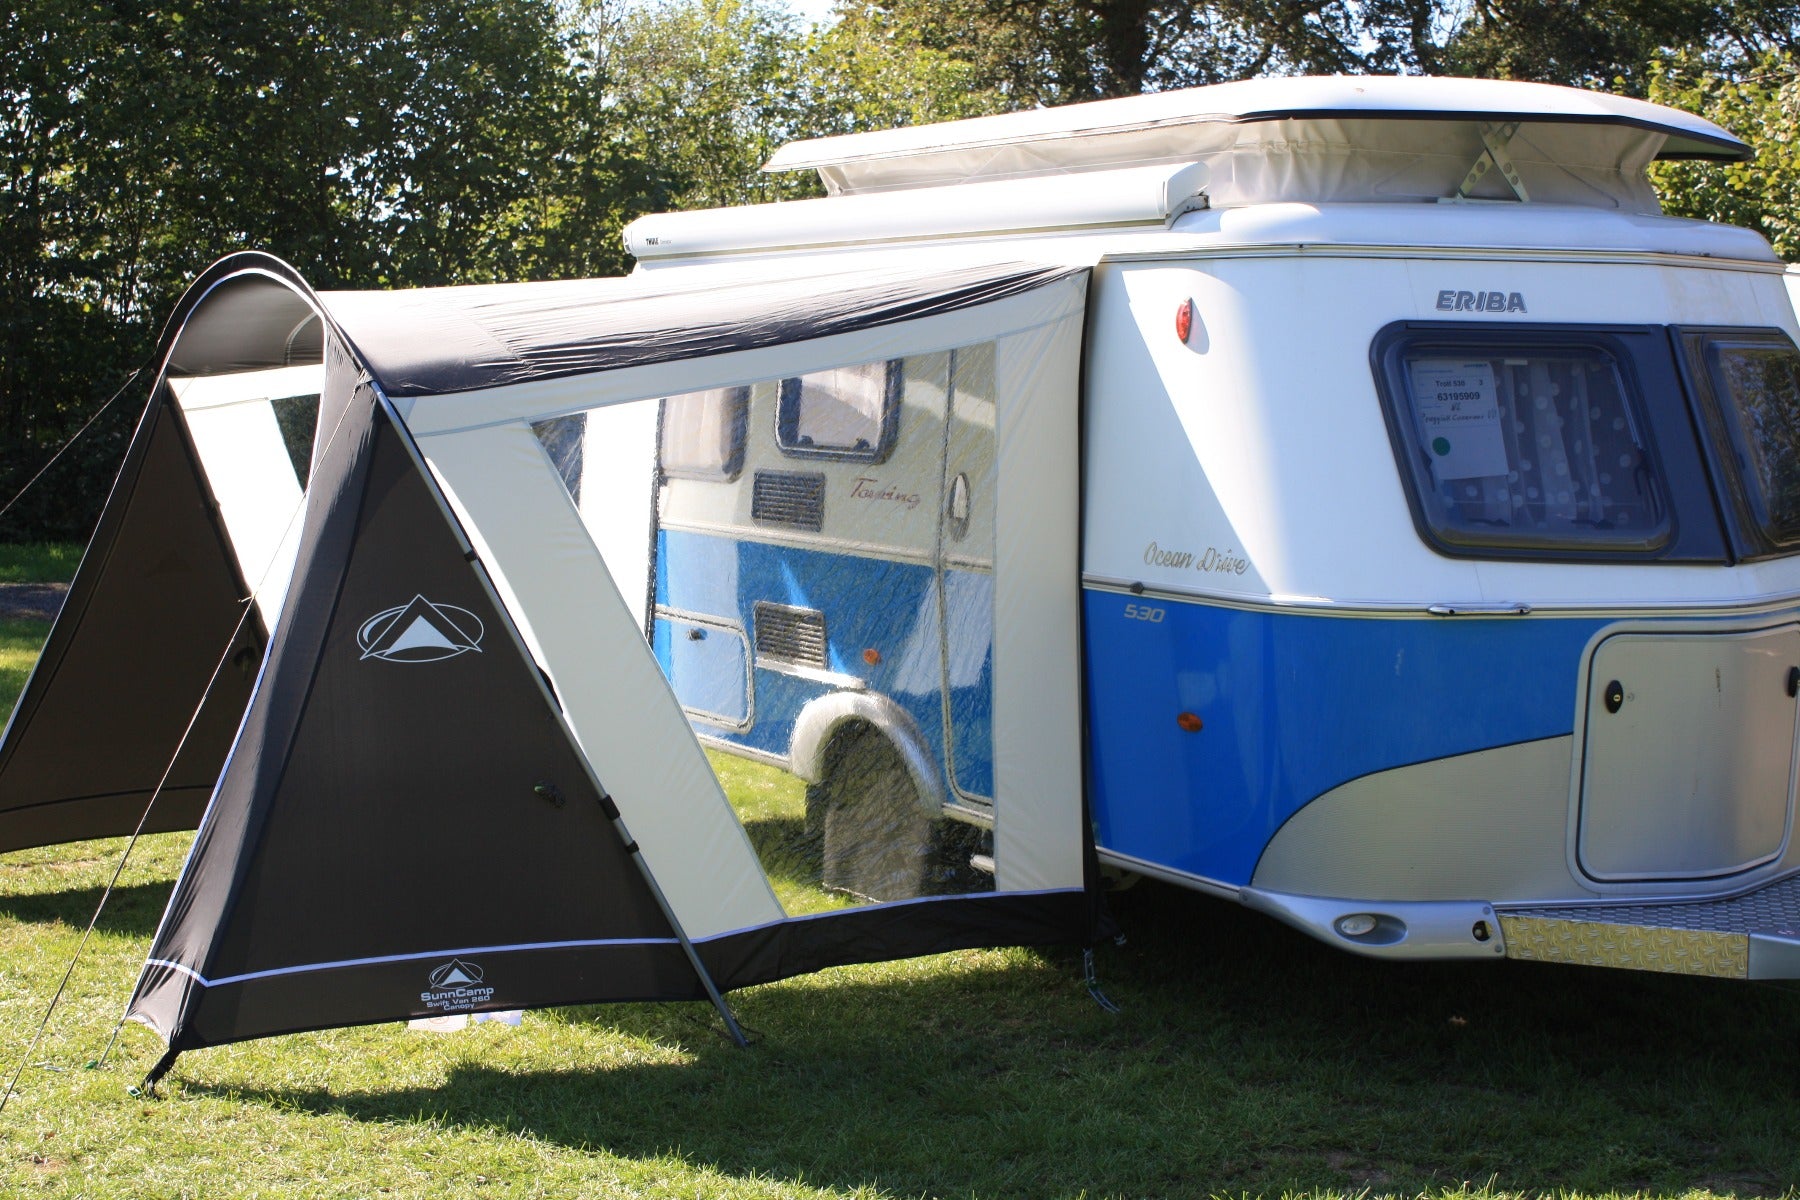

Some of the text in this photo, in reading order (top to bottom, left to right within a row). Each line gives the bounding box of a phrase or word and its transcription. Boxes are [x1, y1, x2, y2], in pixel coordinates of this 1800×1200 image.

[1436, 290, 1528, 313] ERIBA
[1437, 391, 1481, 401] 63195909
[851, 477, 921, 510] Touring
[1143, 541, 1251, 575] Ocean Drive
[1124, 603, 1166, 623] 530
[421, 987, 494, 1002] SunnCamp
[443, 1003, 475, 1011] Canopy
